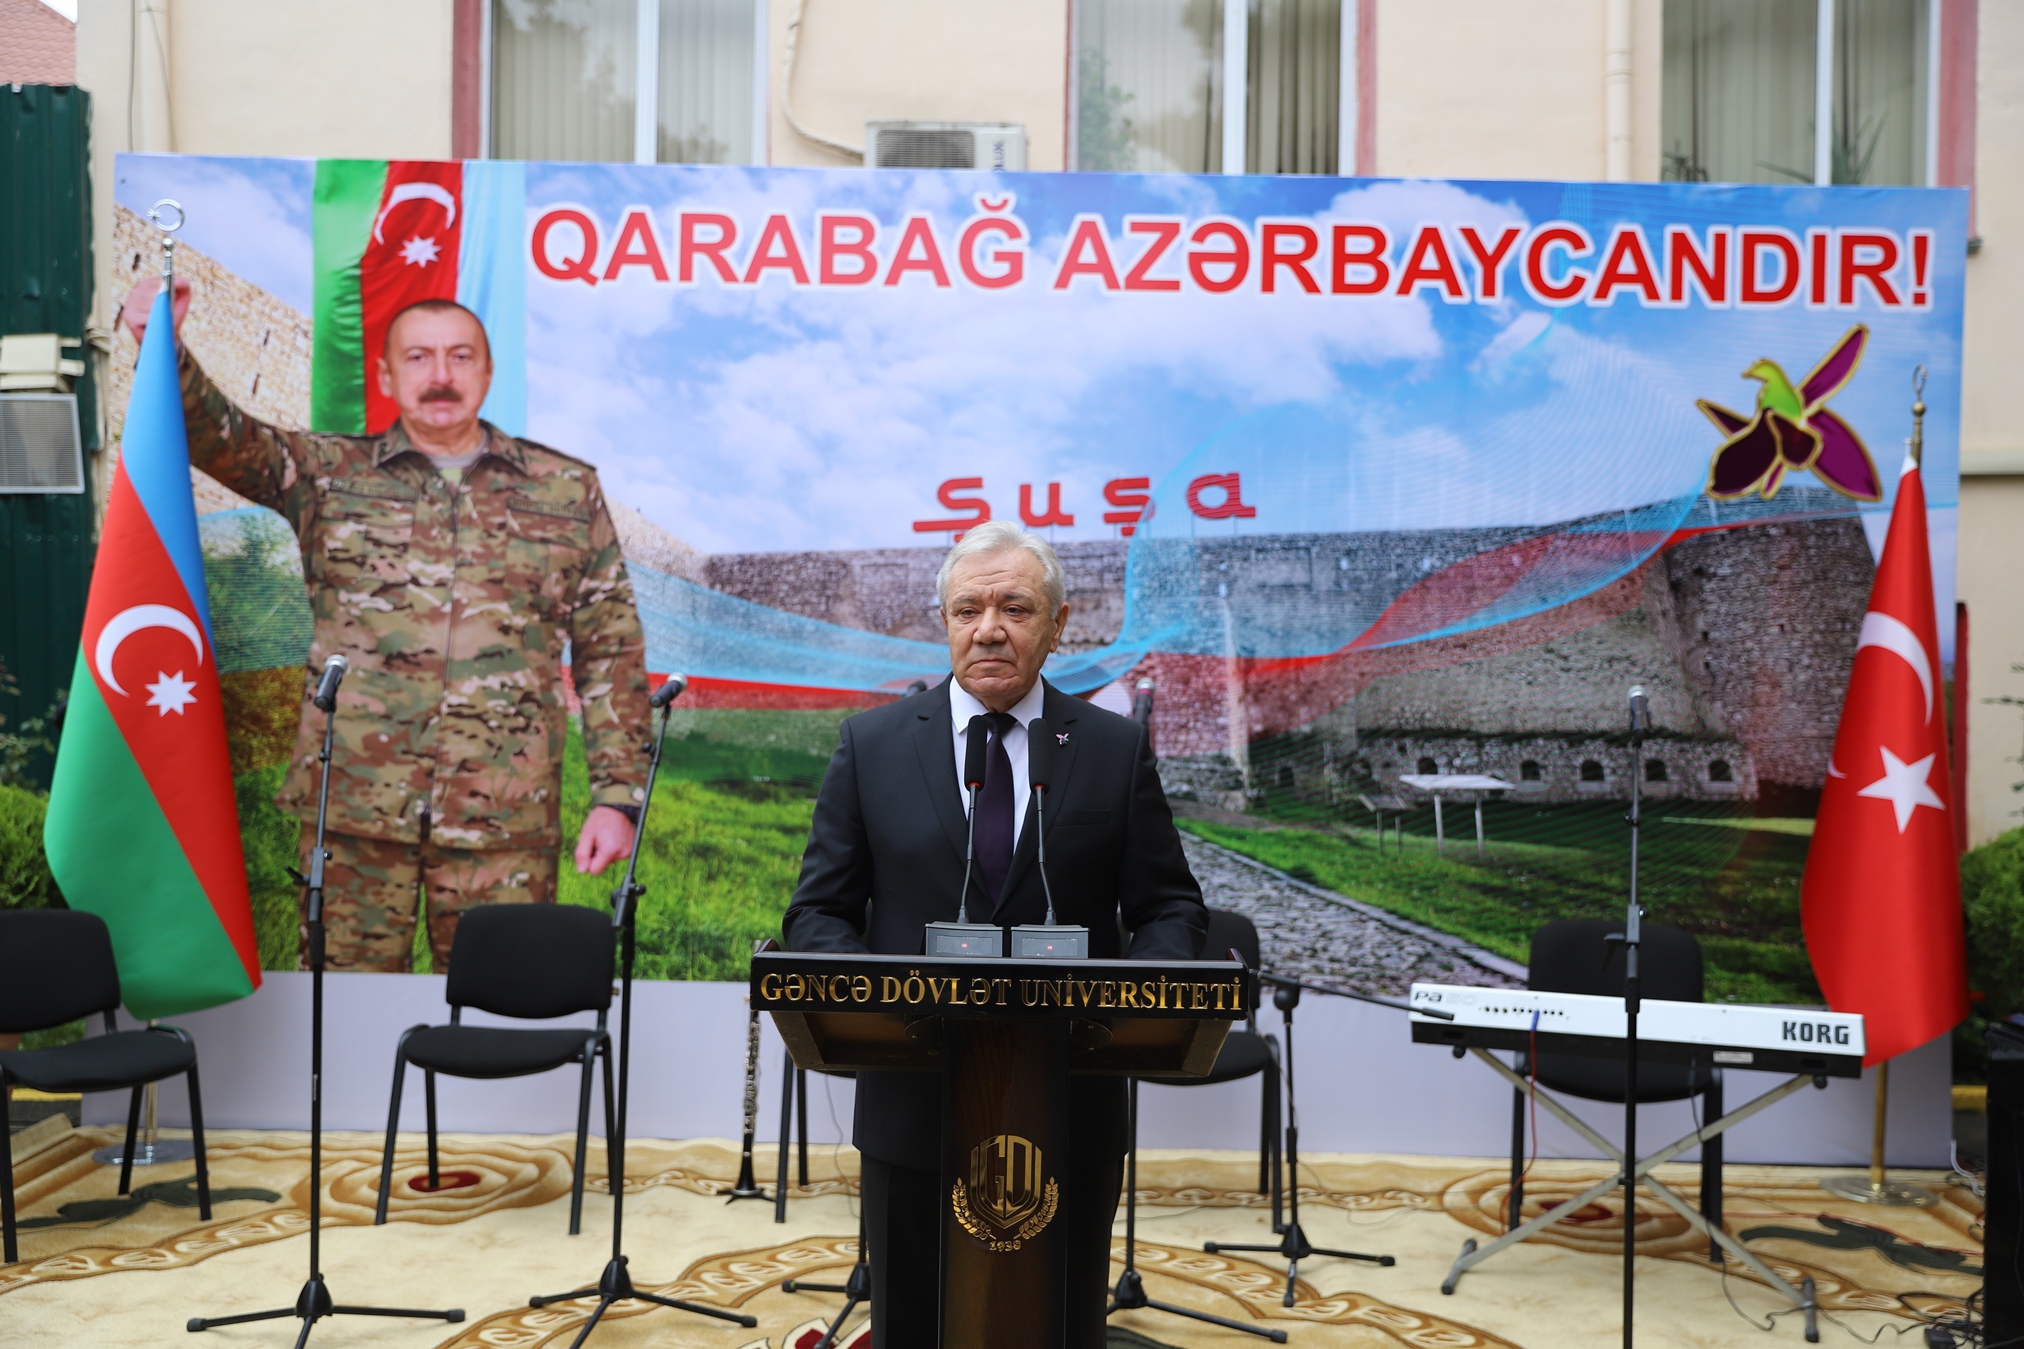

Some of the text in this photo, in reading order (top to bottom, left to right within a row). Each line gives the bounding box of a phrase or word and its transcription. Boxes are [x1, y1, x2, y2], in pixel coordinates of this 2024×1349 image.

[531, 198, 1930, 306] QARABAĞ AZƏRBAYCANDIR!
[760, 969, 1242, 1011] GƏNCƏ DÖVLƏT UNİVERSİTETİ
[1783, 1021, 1849, 1045] KORG
[989, 1240, 1022, 1252] 1938
